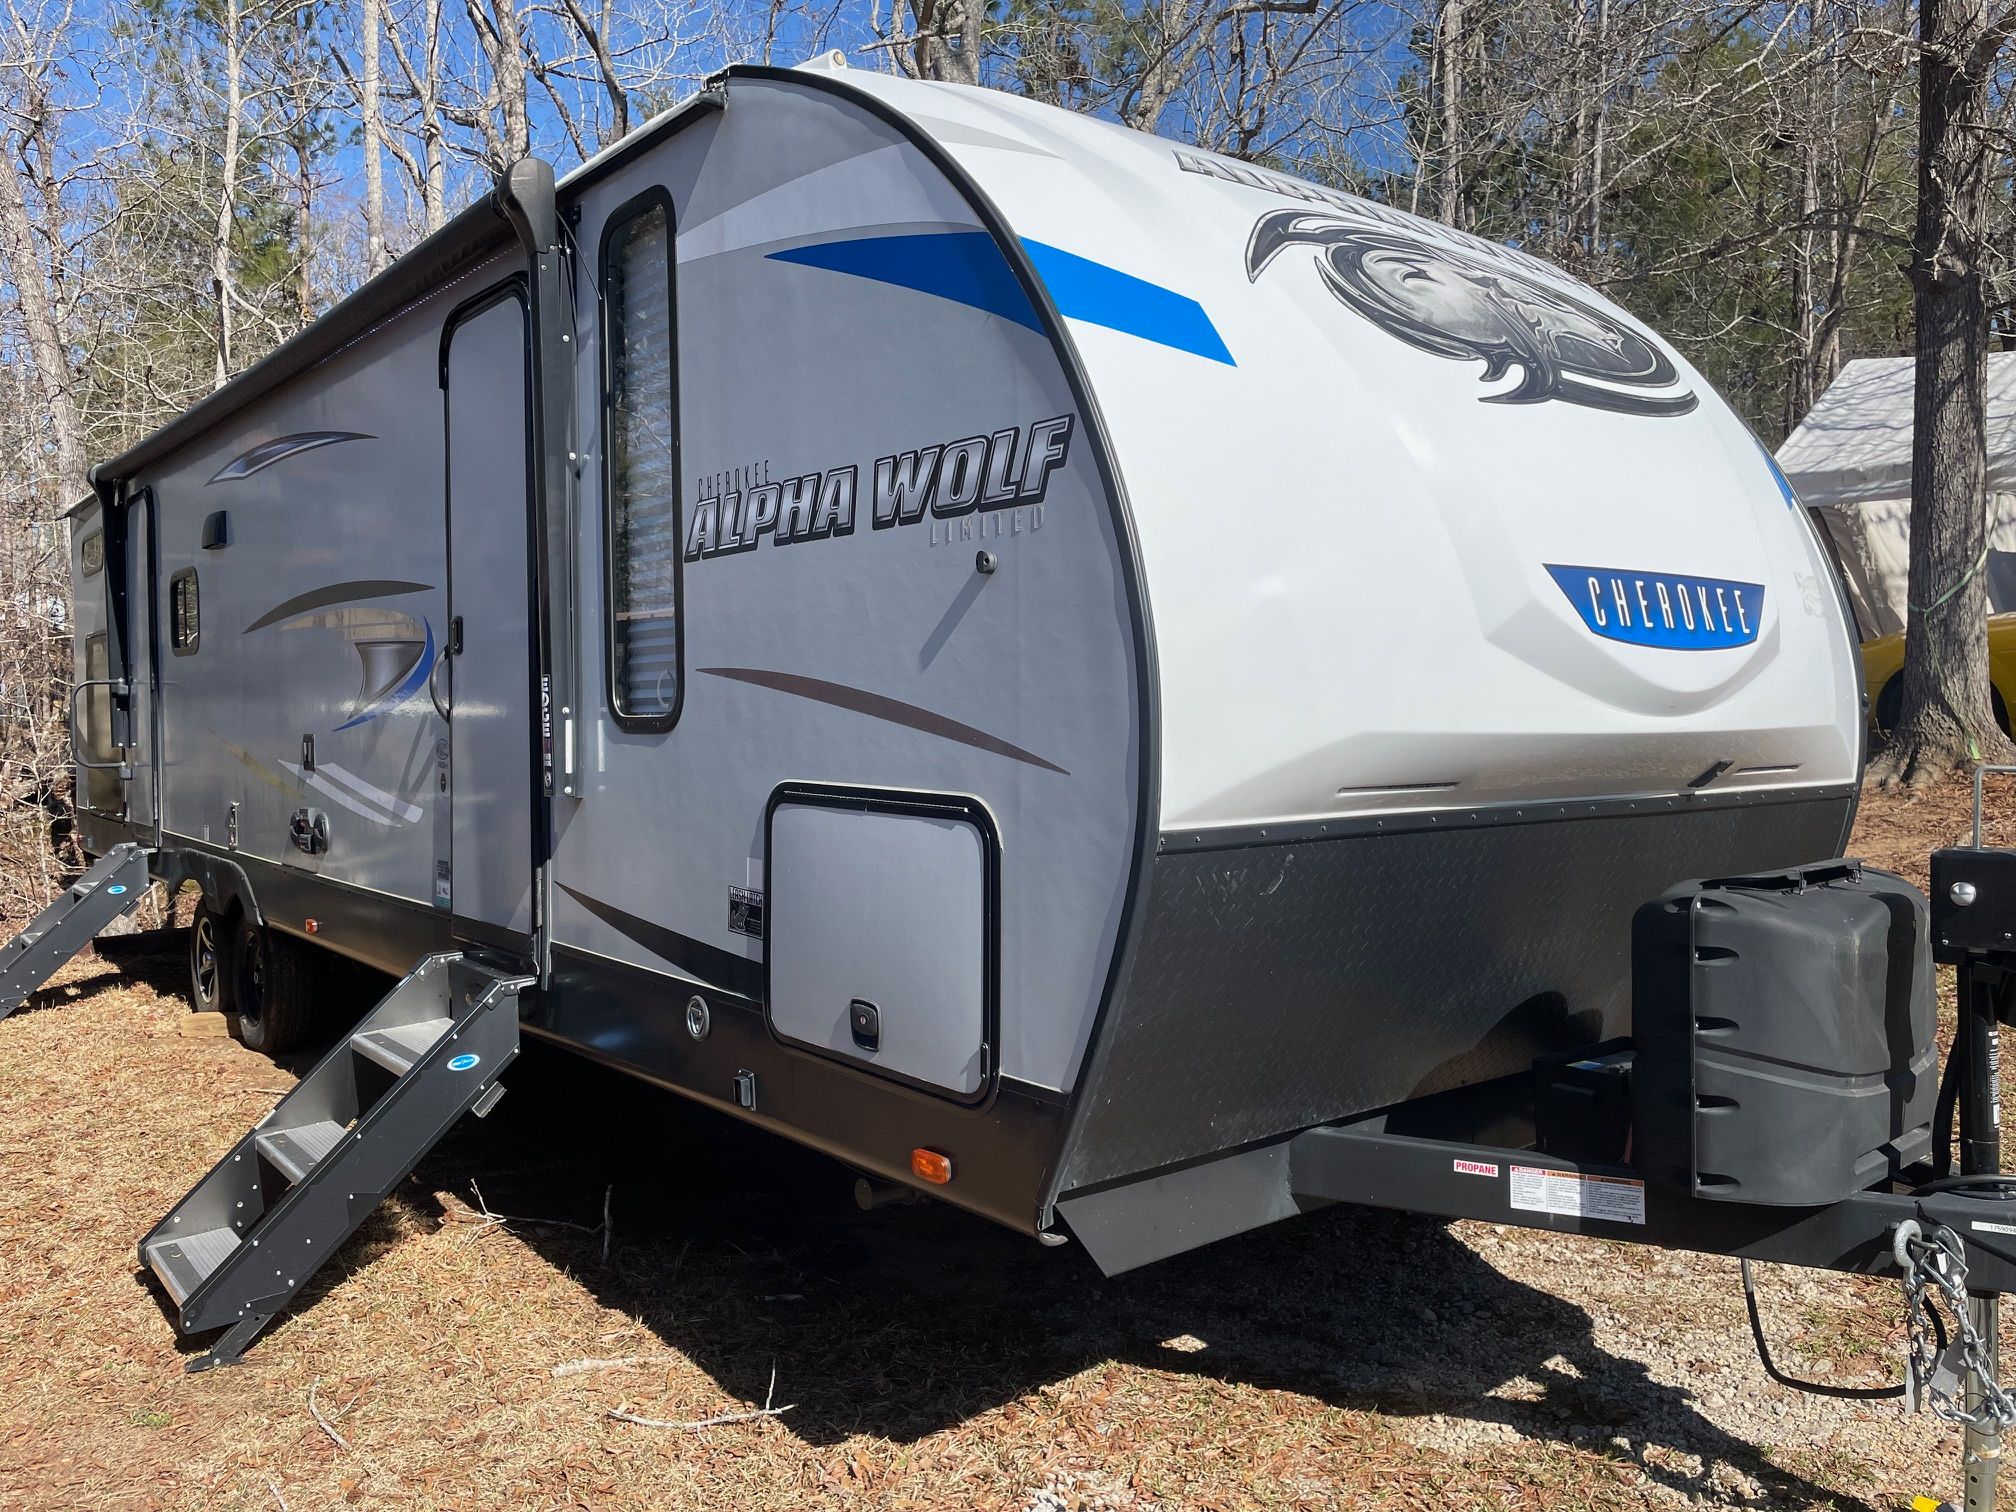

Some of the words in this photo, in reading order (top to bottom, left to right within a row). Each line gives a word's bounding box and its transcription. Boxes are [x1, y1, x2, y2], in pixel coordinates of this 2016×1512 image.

[684, 464, 859, 563] ALPHA
[872, 413, 1076, 531] WOLF
[698, 460, 769, 500] CHEROKEE
[930, 504, 1045, 546] LIMITED
[1587, 576, 1751, 634] CHEROKEE
[1455, 1161, 1497, 1175] PROPANE
